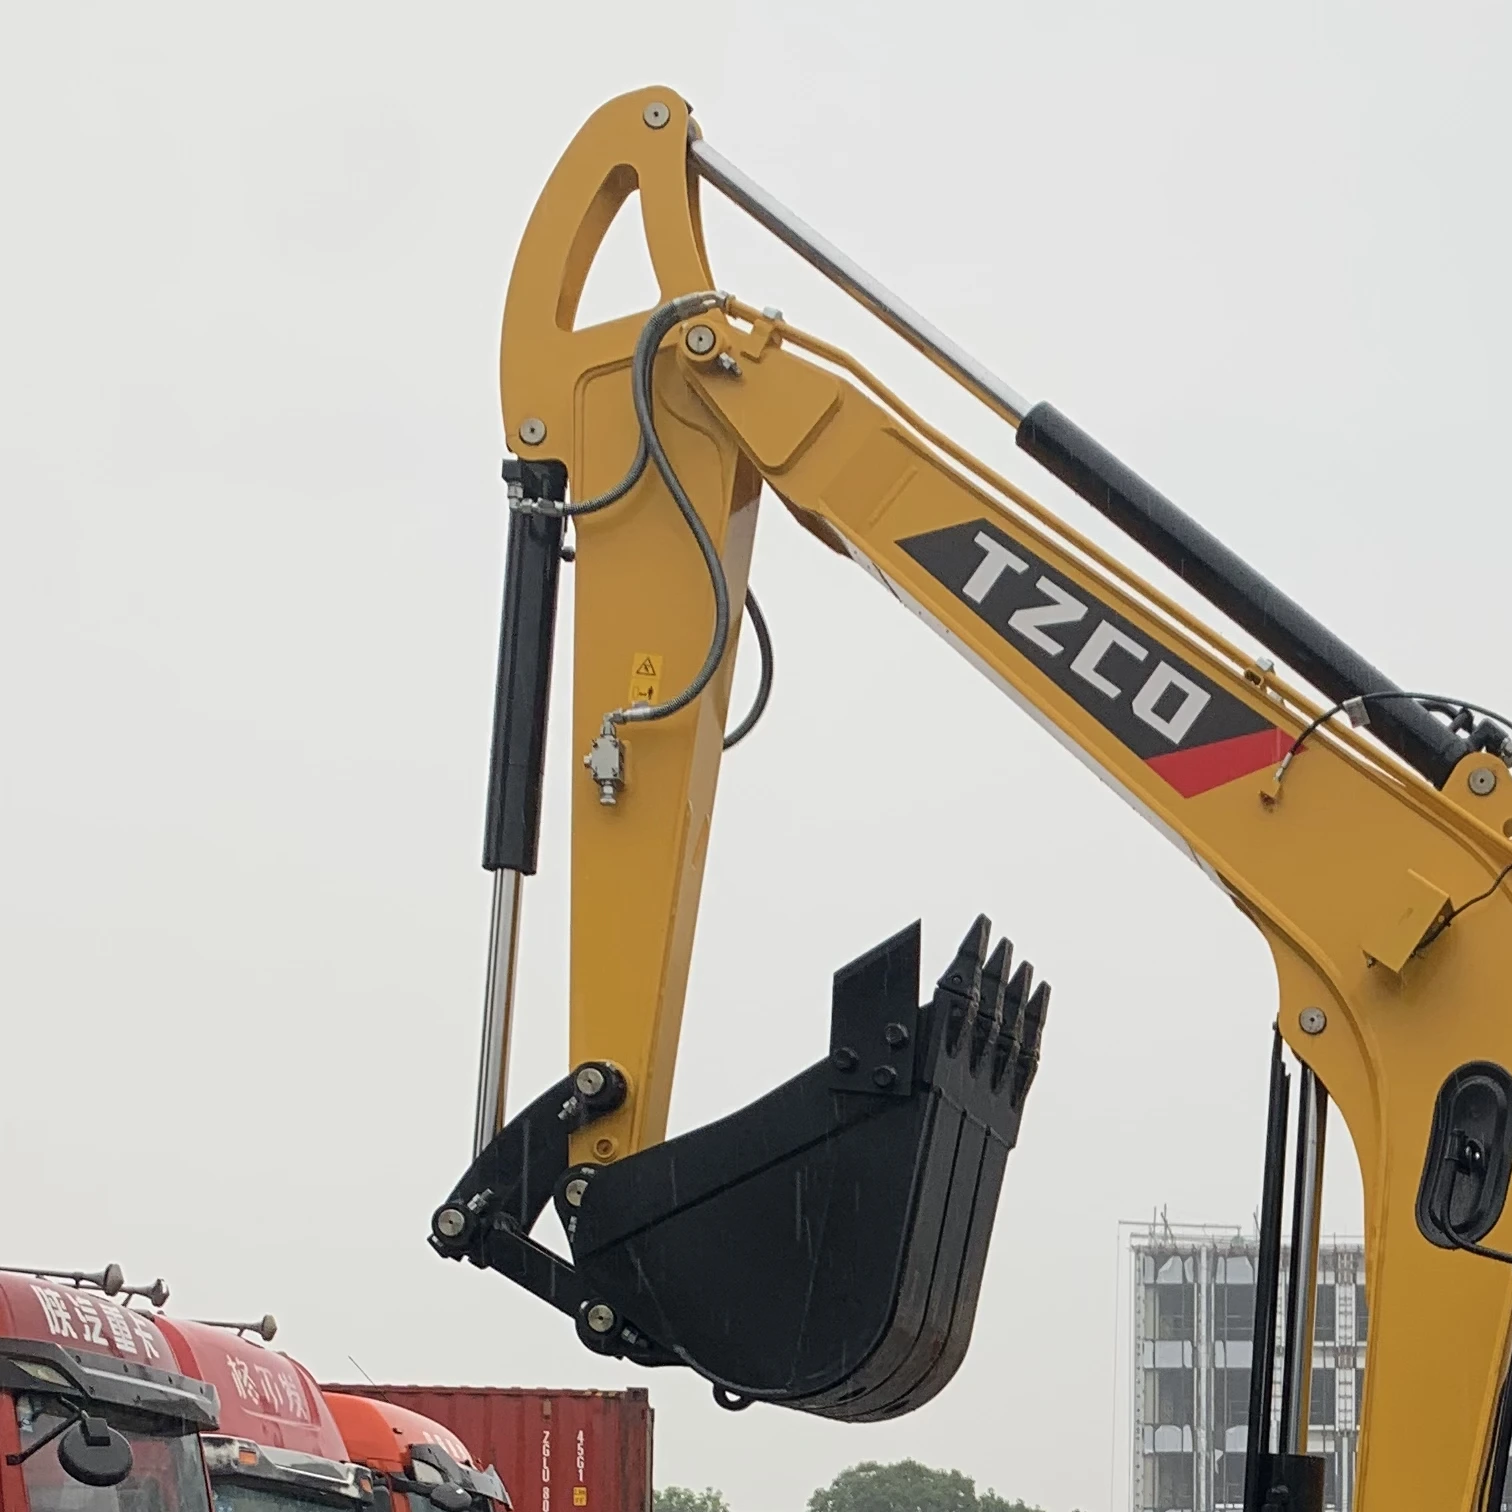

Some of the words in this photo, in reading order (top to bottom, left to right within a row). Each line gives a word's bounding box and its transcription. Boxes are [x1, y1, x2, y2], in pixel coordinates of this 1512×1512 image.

[962, 530, 1212, 745] TZCO
[30, 1284, 161, 1360] 陕汽重卡
[542, 1430, 551, 1483] ZGLU
[576, 1430, 585, 1483] 45G1
